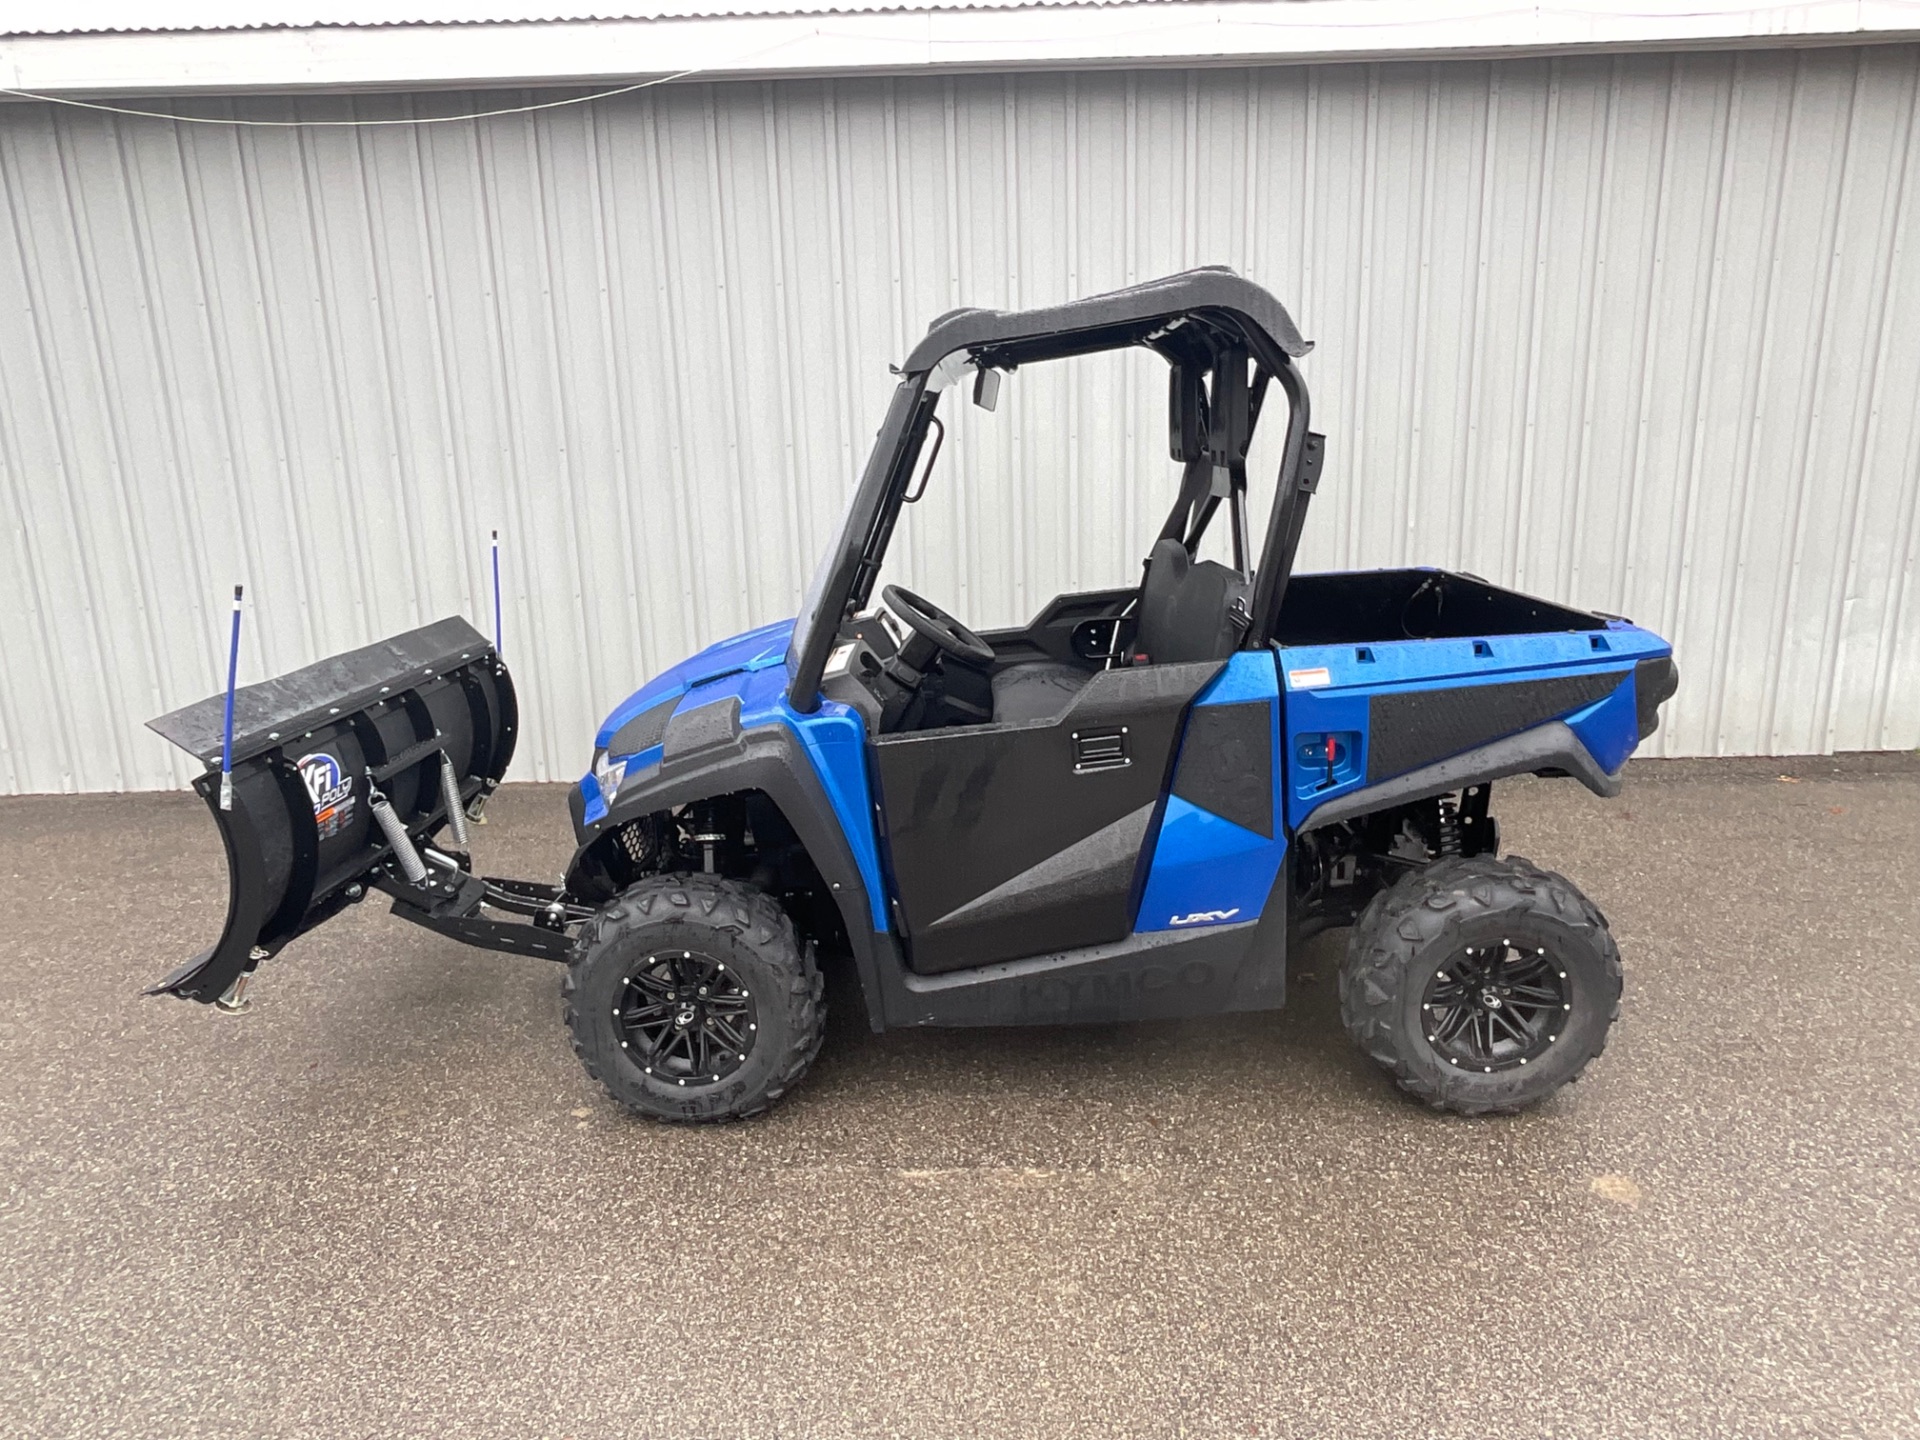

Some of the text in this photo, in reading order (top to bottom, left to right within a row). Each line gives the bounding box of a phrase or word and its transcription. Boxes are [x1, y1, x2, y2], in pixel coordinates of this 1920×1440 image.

[321, 780, 351, 806] POLY
[1169, 908, 1240, 925] UXV
[1019, 959, 1216, 1011] KYMCO
